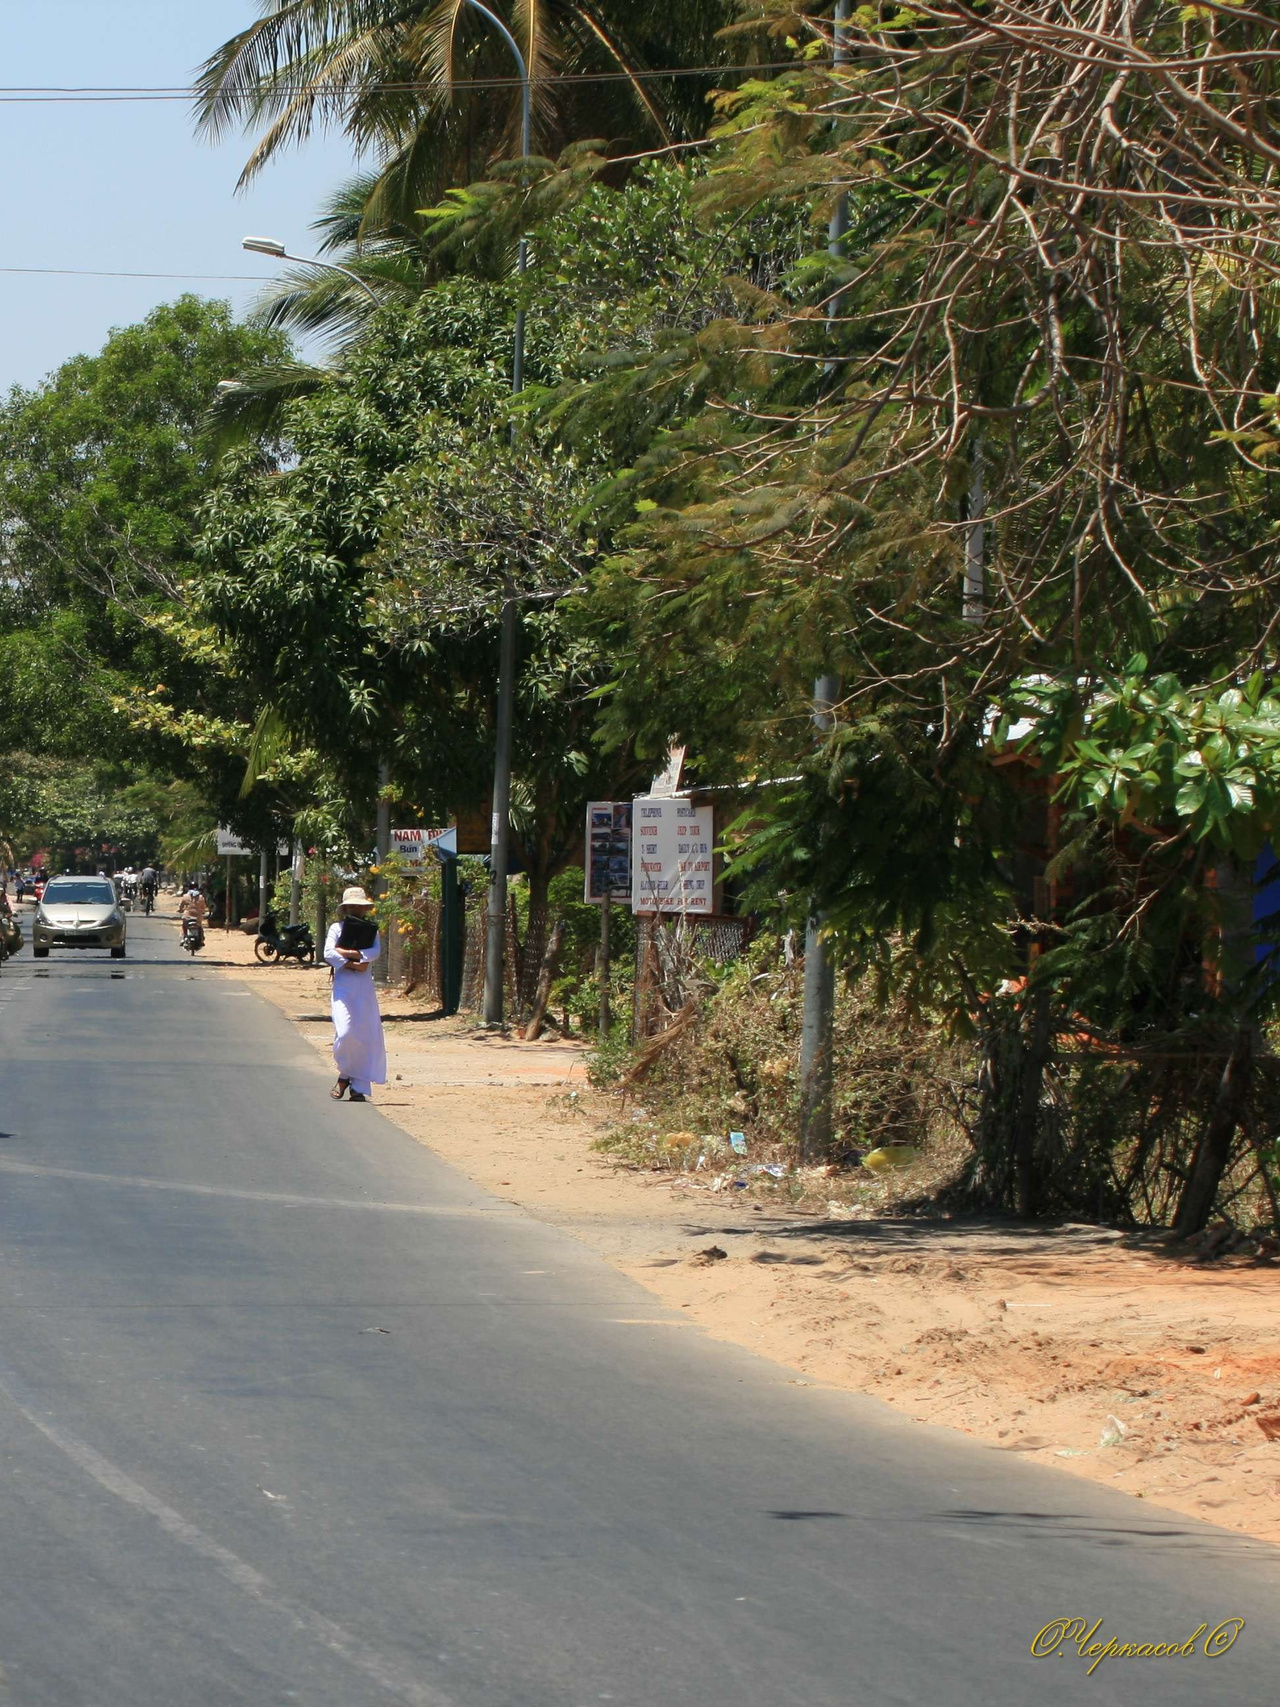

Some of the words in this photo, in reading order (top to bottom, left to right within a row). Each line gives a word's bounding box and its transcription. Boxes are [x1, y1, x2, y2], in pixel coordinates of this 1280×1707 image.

[394, 830, 421, 841] NAM
[400, 844, 417, 853] Bún
[690, 897, 707, 906] RENT
